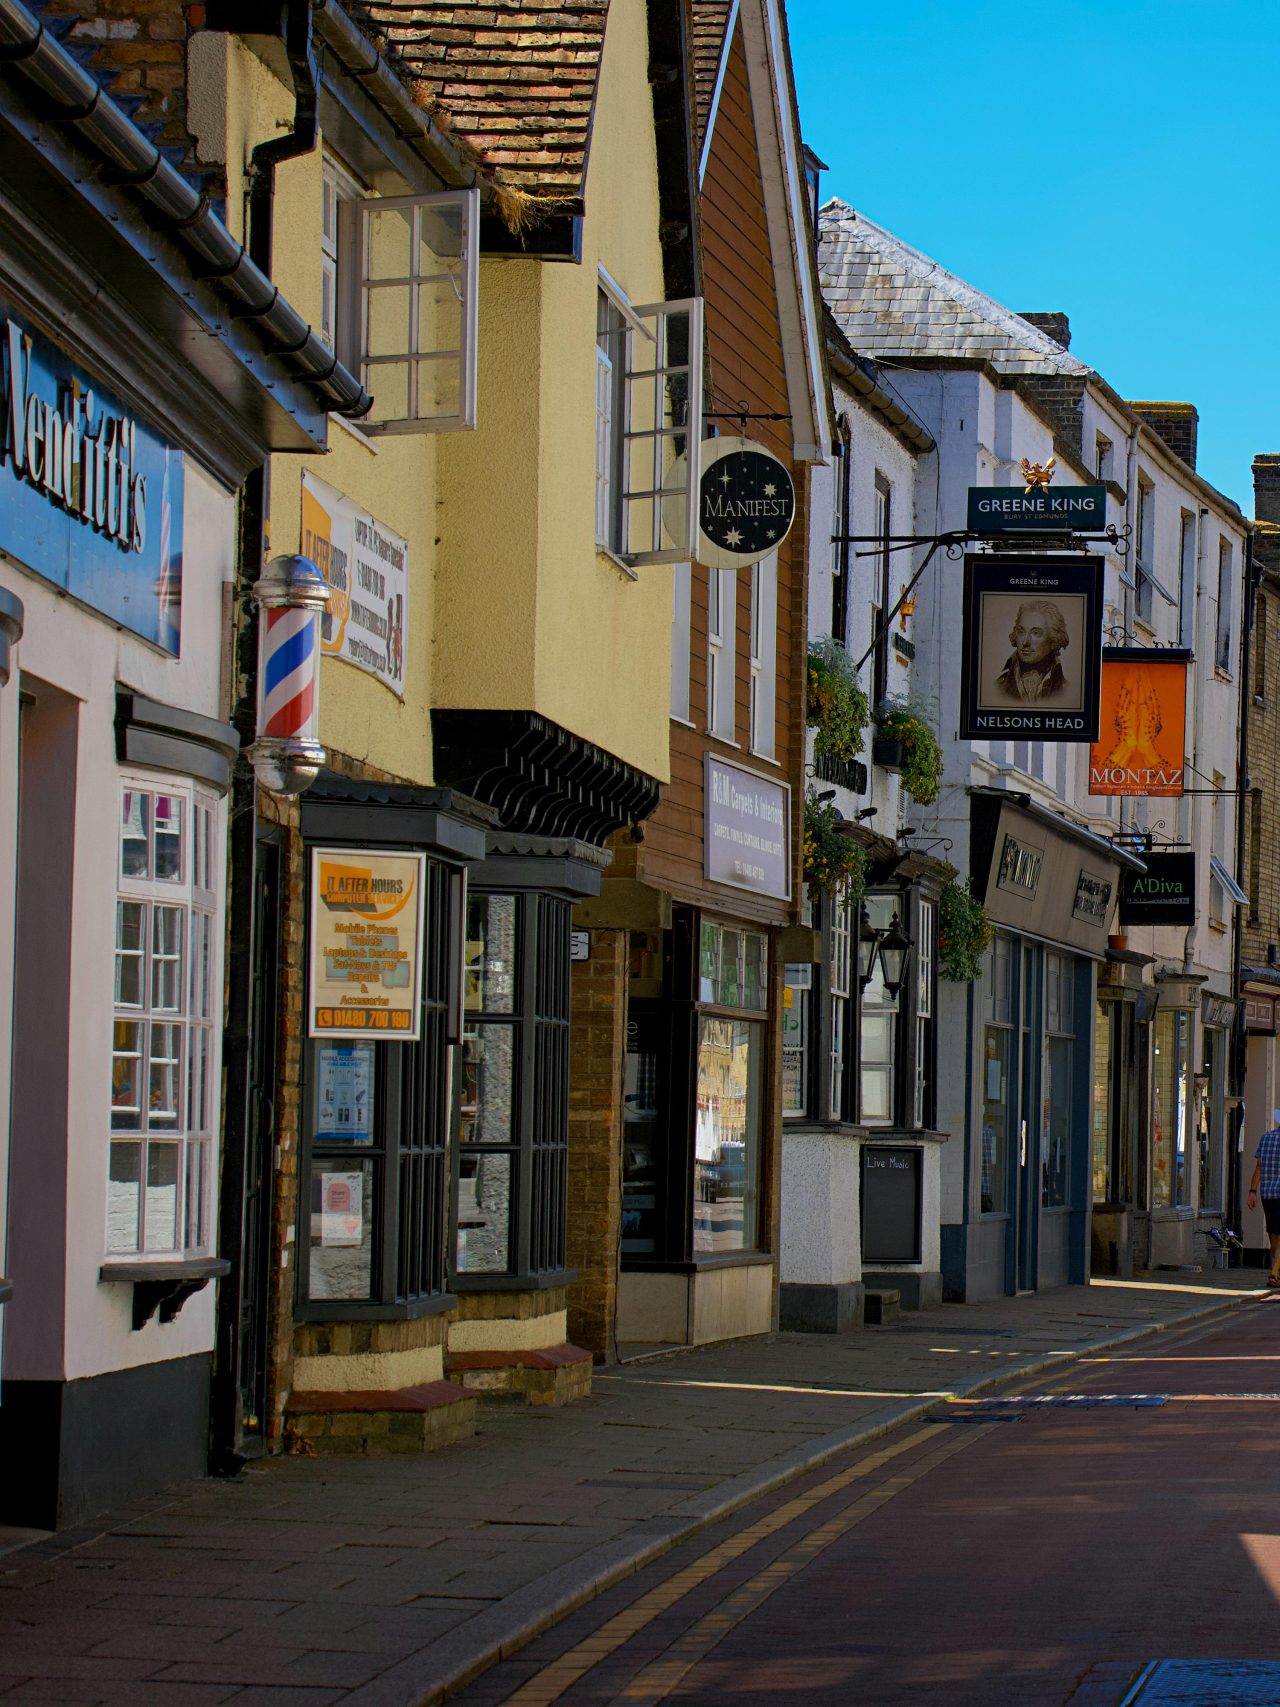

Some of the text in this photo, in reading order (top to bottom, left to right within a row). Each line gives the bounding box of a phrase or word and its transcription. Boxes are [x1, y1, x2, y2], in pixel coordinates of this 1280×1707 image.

[6, 318, 147, 554] Venditti's
[978, 498, 1095, 512] GREENE KING
[1040, 578, 1059, 586] KING
[976, 716, 1084, 729] NELSONS HEAD
[1090, 767, 1182, 785] MONTAZ
[730, 785, 754, 816] Carpets
[327, 876, 404, 894] IT AFTER HOURS
[1132, 877, 1183, 894] A'Diva
[334, 923, 366, 934] Mobile
[340, 995, 390, 1006] Accessories
[333, 1009, 367, 1027] 01480
[368, 1010, 389, 1028] 700
[867, 1156, 909, 1169] Live Music
